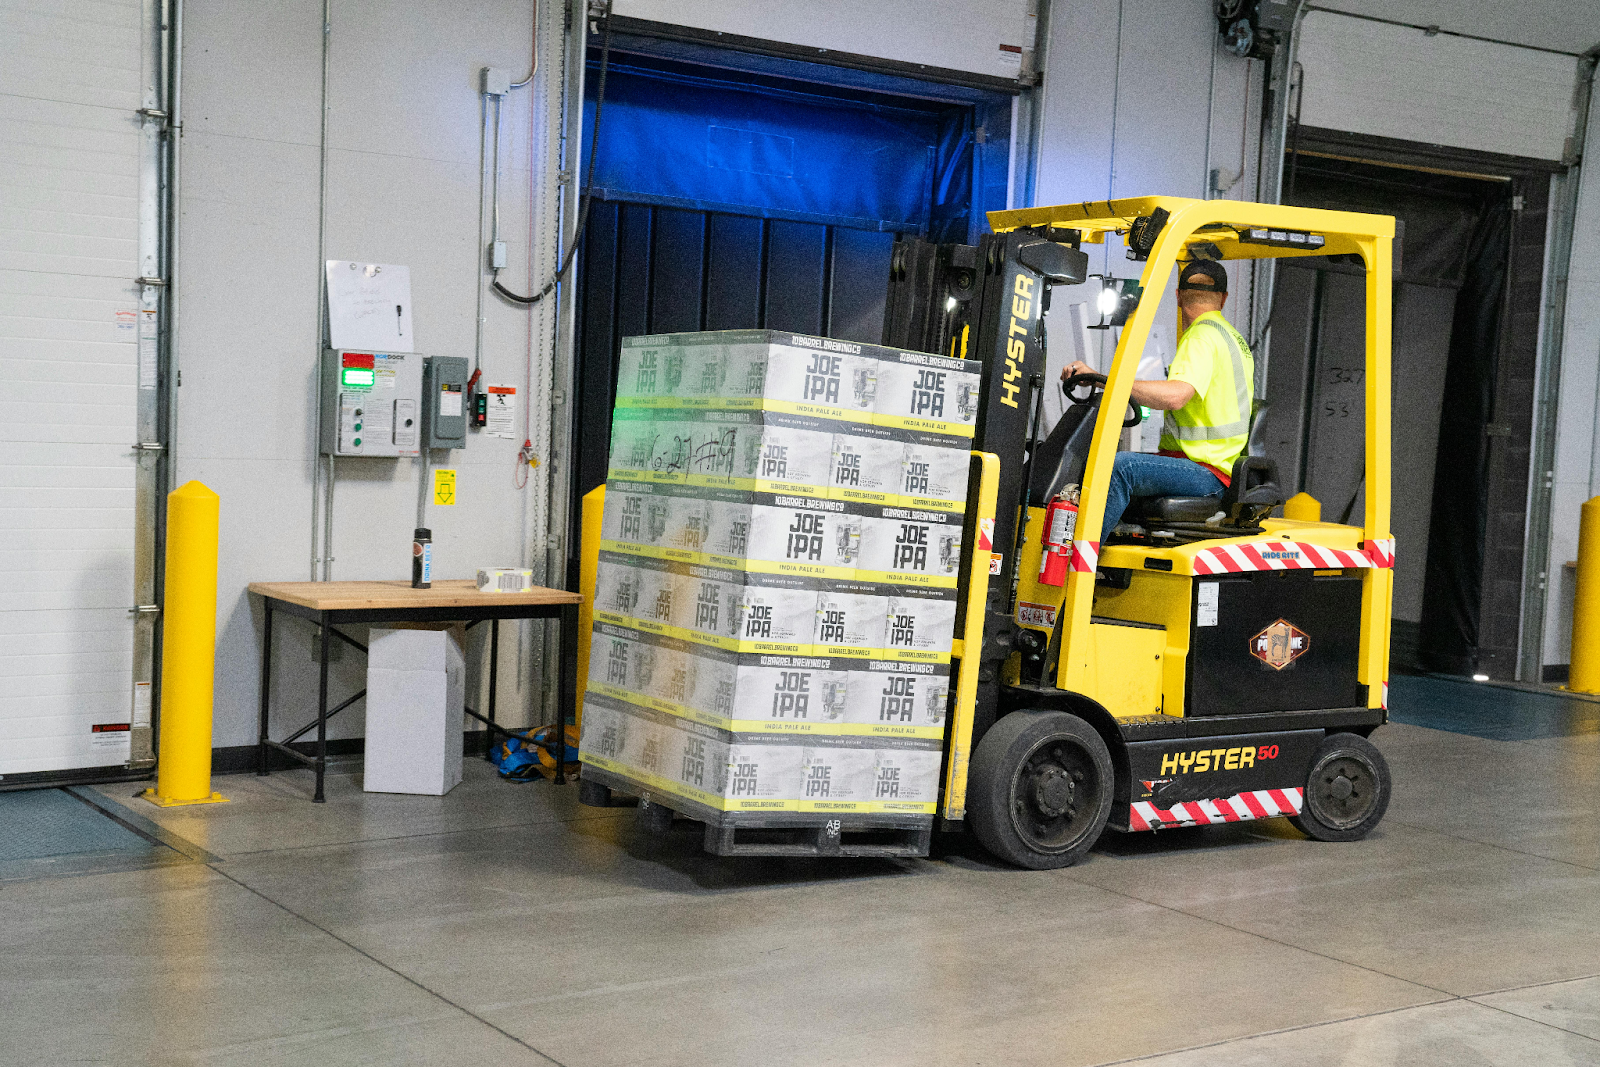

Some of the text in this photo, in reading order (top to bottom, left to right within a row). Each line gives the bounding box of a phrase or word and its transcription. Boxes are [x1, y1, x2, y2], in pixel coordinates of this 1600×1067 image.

[1000, 273, 1034, 409] HYSTER
[807, 354, 842, 376] JOE
[804, 374, 840, 403] IPA
[913, 370, 946, 392] JOE
[910, 391, 944, 417] IPA
[763, 444, 788, 460] JOE
[838, 453, 861, 468] JOE
[762, 459, 787, 478] IPA
[836, 468, 859, 485] IPA
[907, 462, 930, 477] JOE
[905, 477, 928, 494] IPA
[623, 496, 641, 514] JOE
[620, 515, 640, 540] IPA
[790, 512, 825, 534] JOE
[896, 524, 929, 545] JOE
[786, 533, 823, 560] IPA
[893, 545, 927, 570] IPA
[657, 590, 672, 603] JOE
[698, 583, 720, 604] JOE
[655, 603, 670, 620] IPA
[695, 603, 718, 630] IPA
[748, 605, 772, 620] JOE
[822, 611, 845, 625] JOE
[746, 620, 771, 638] IPA
[893, 615, 915, 629] JOE
[820, 624, 844, 642] IPA
[891, 628, 913, 646] IPA
[609, 640, 628, 660] JOE
[607, 660, 627, 685] IPA
[775, 672, 811, 692] JOE
[882, 677, 916, 697] JOE
[772, 693, 808, 718] IPA
[880, 697, 914, 722] IPA
[684, 736, 706, 759] JOE
[1160, 745, 1279, 776] HYSTER 50
[682, 757, 703, 786] IPA
[734, 764, 758, 778] JOE
[808, 766, 831, 780] JOE
[878, 768, 900, 781] JOE
[732, 778, 756, 795] IPA
[806, 780, 829, 797] IPA
[876, 782, 899, 797] IPA
[826, 820, 840, 830] AB
